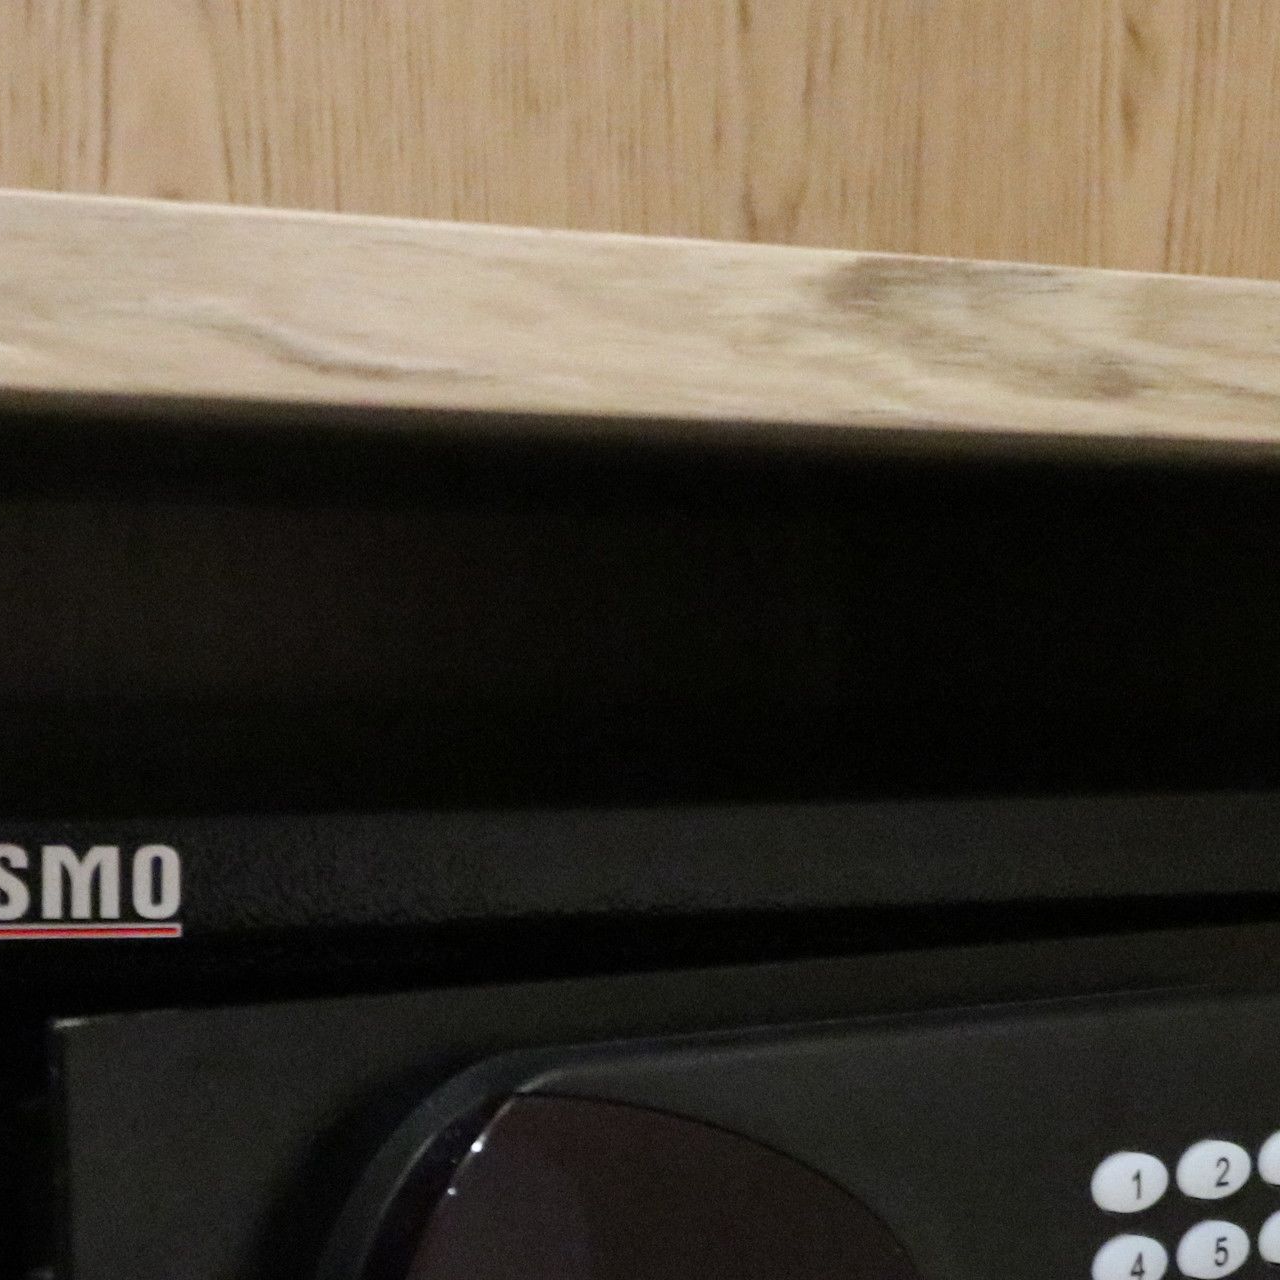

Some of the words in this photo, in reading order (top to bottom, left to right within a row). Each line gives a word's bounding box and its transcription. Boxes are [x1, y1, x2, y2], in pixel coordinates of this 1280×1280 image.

[1131, 1169, 1143, 1200] 1
[1216, 1157, 1230, 1188] 2
[1215, 1237, 1229, 1267] 5
